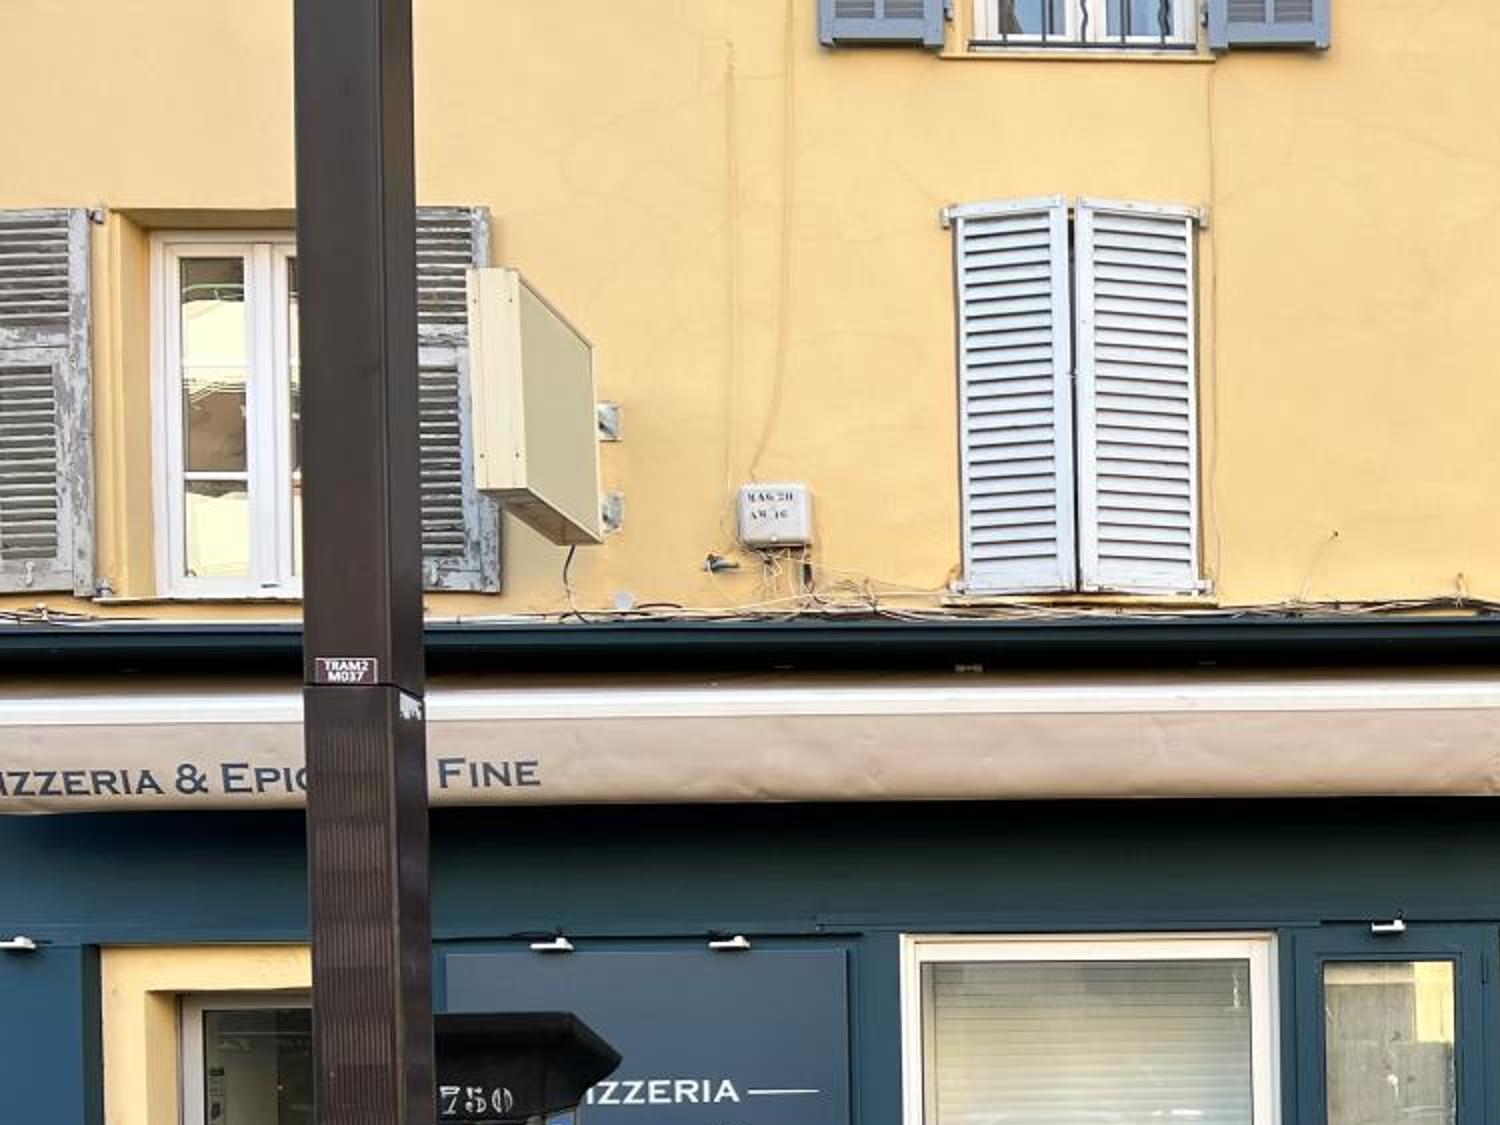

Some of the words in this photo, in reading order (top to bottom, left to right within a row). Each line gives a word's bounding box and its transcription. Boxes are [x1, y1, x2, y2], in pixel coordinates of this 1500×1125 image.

[325, 660, 369, 671] TRAM2
[0, 769, 165, 796] IZZERIA
[175, 763, 208, 794] &
[438, 757, 542, 788] FINE
[585, 1079, 741, 1105] IZZERIA
